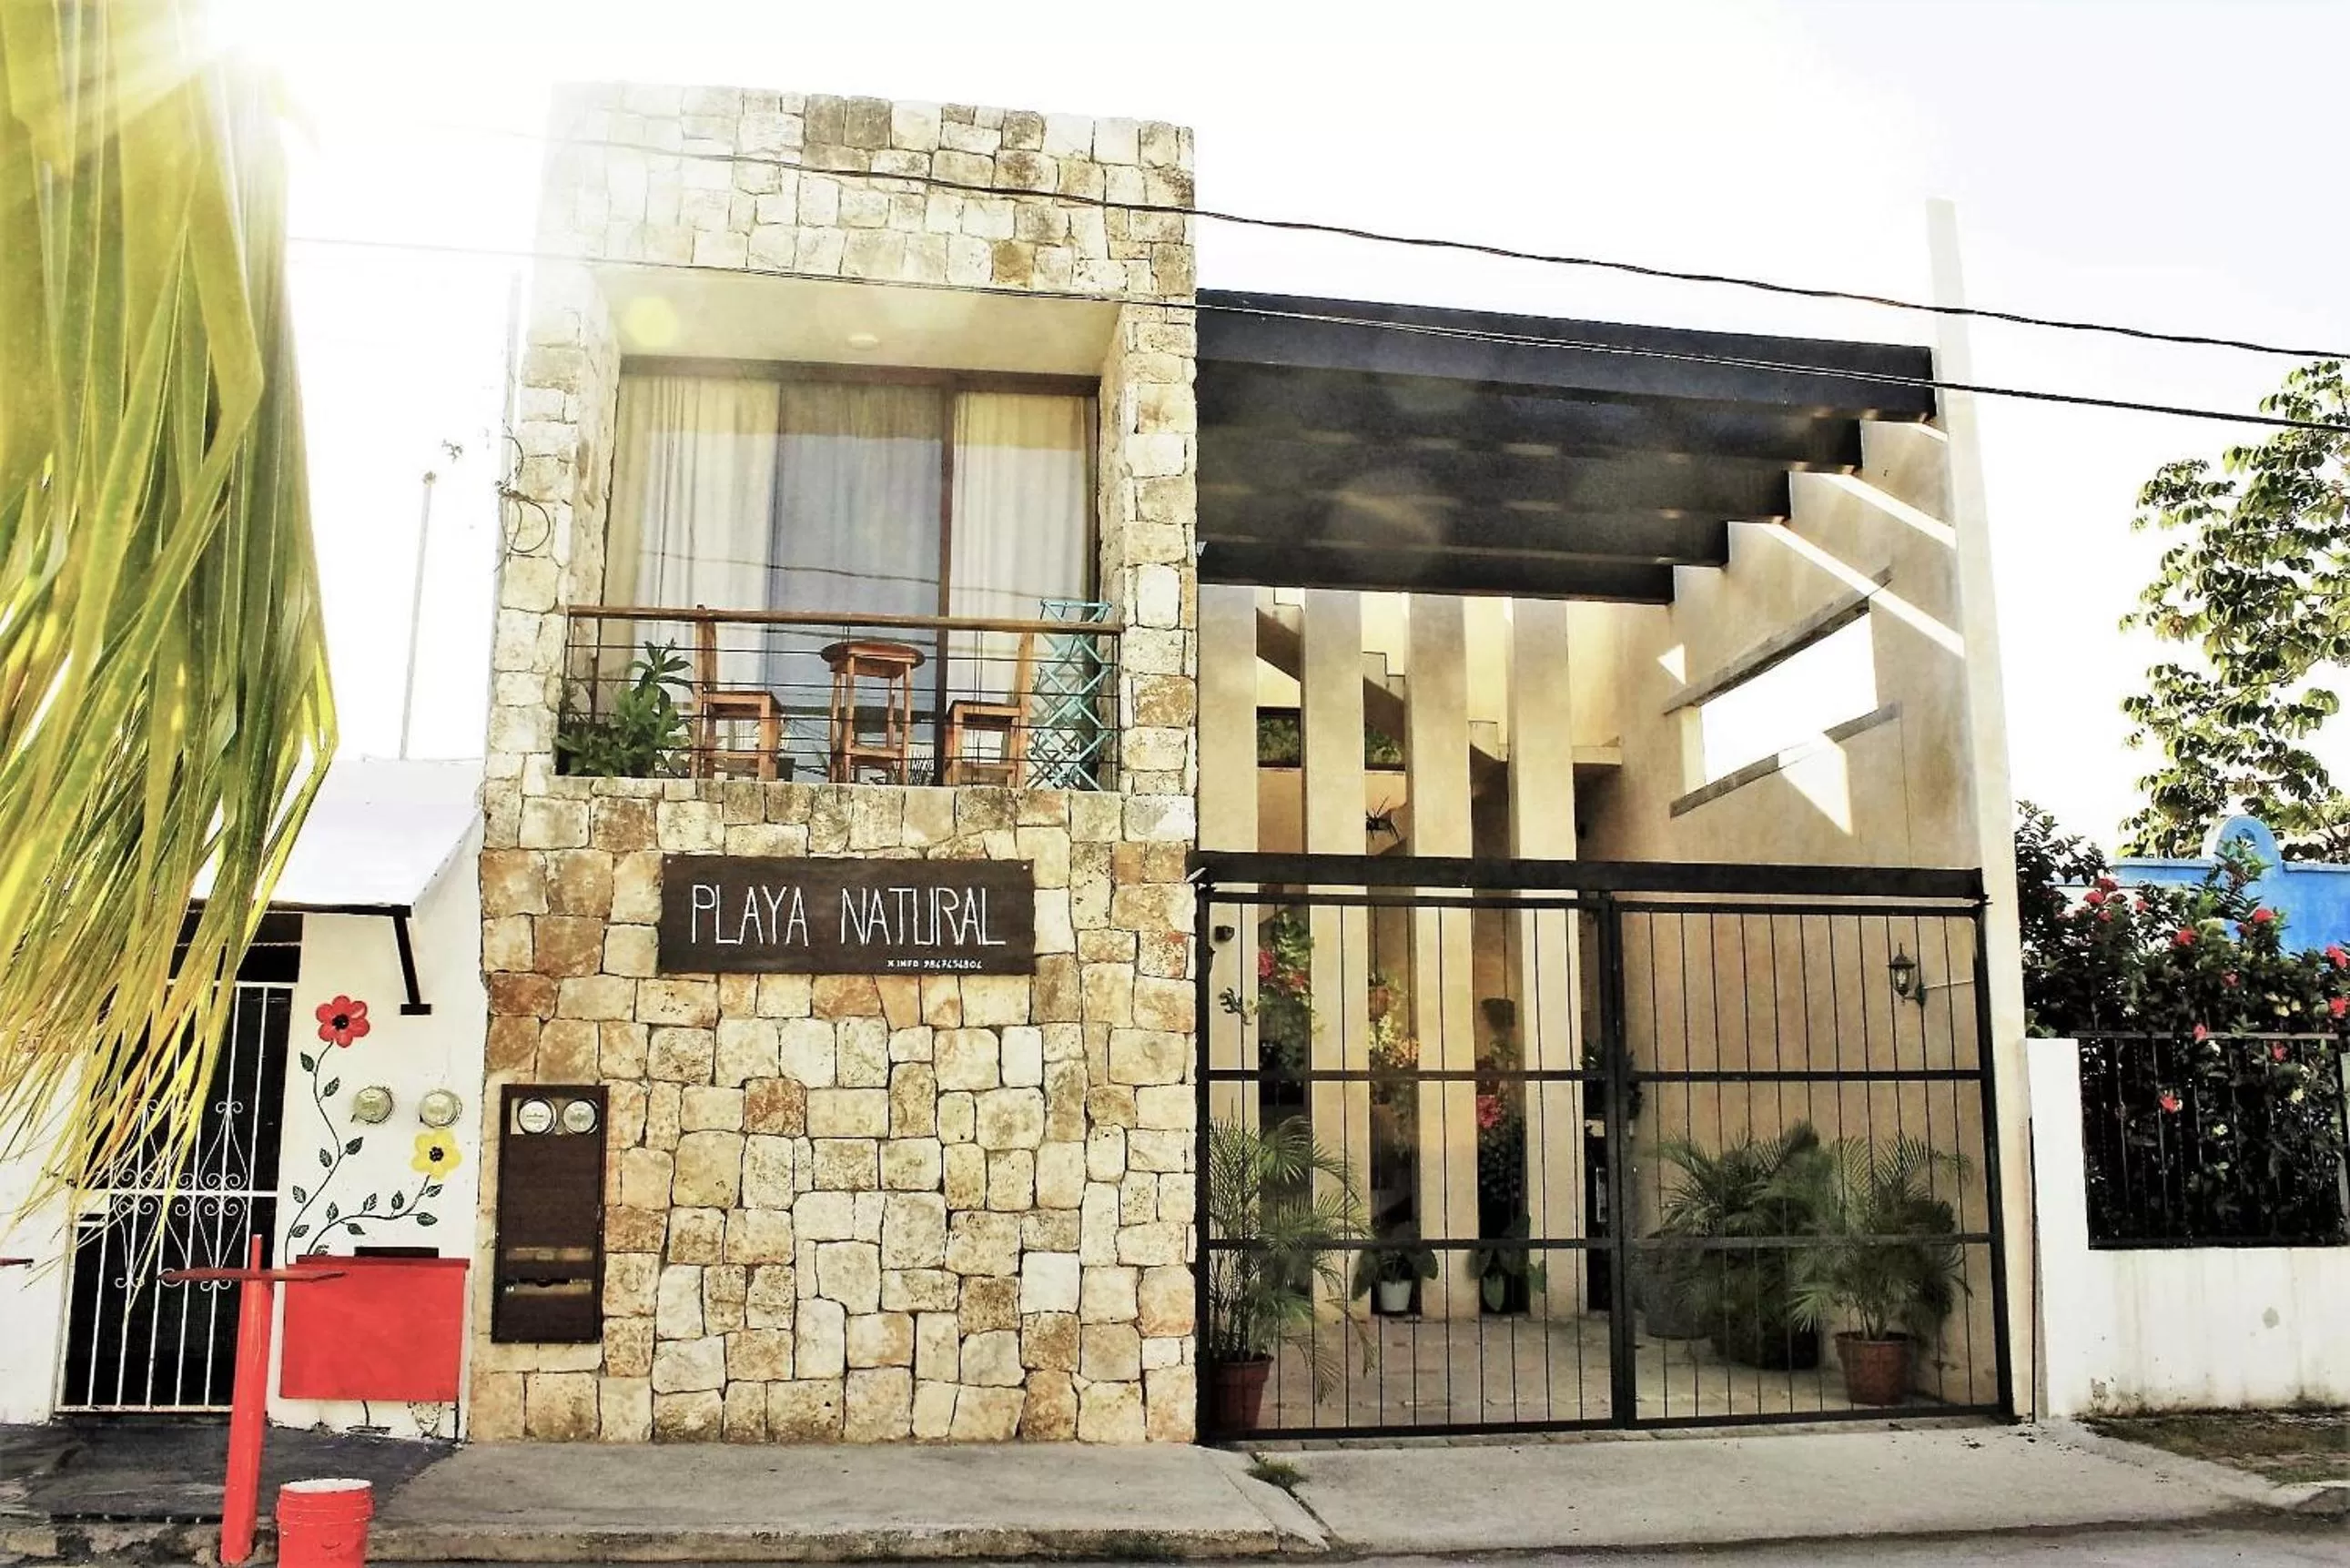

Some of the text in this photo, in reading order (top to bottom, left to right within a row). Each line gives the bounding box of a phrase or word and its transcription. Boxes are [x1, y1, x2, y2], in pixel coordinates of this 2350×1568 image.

[690, 884, 1008, 947] PLAYA NATURAL
[896, 959, 919, 968] INFO
